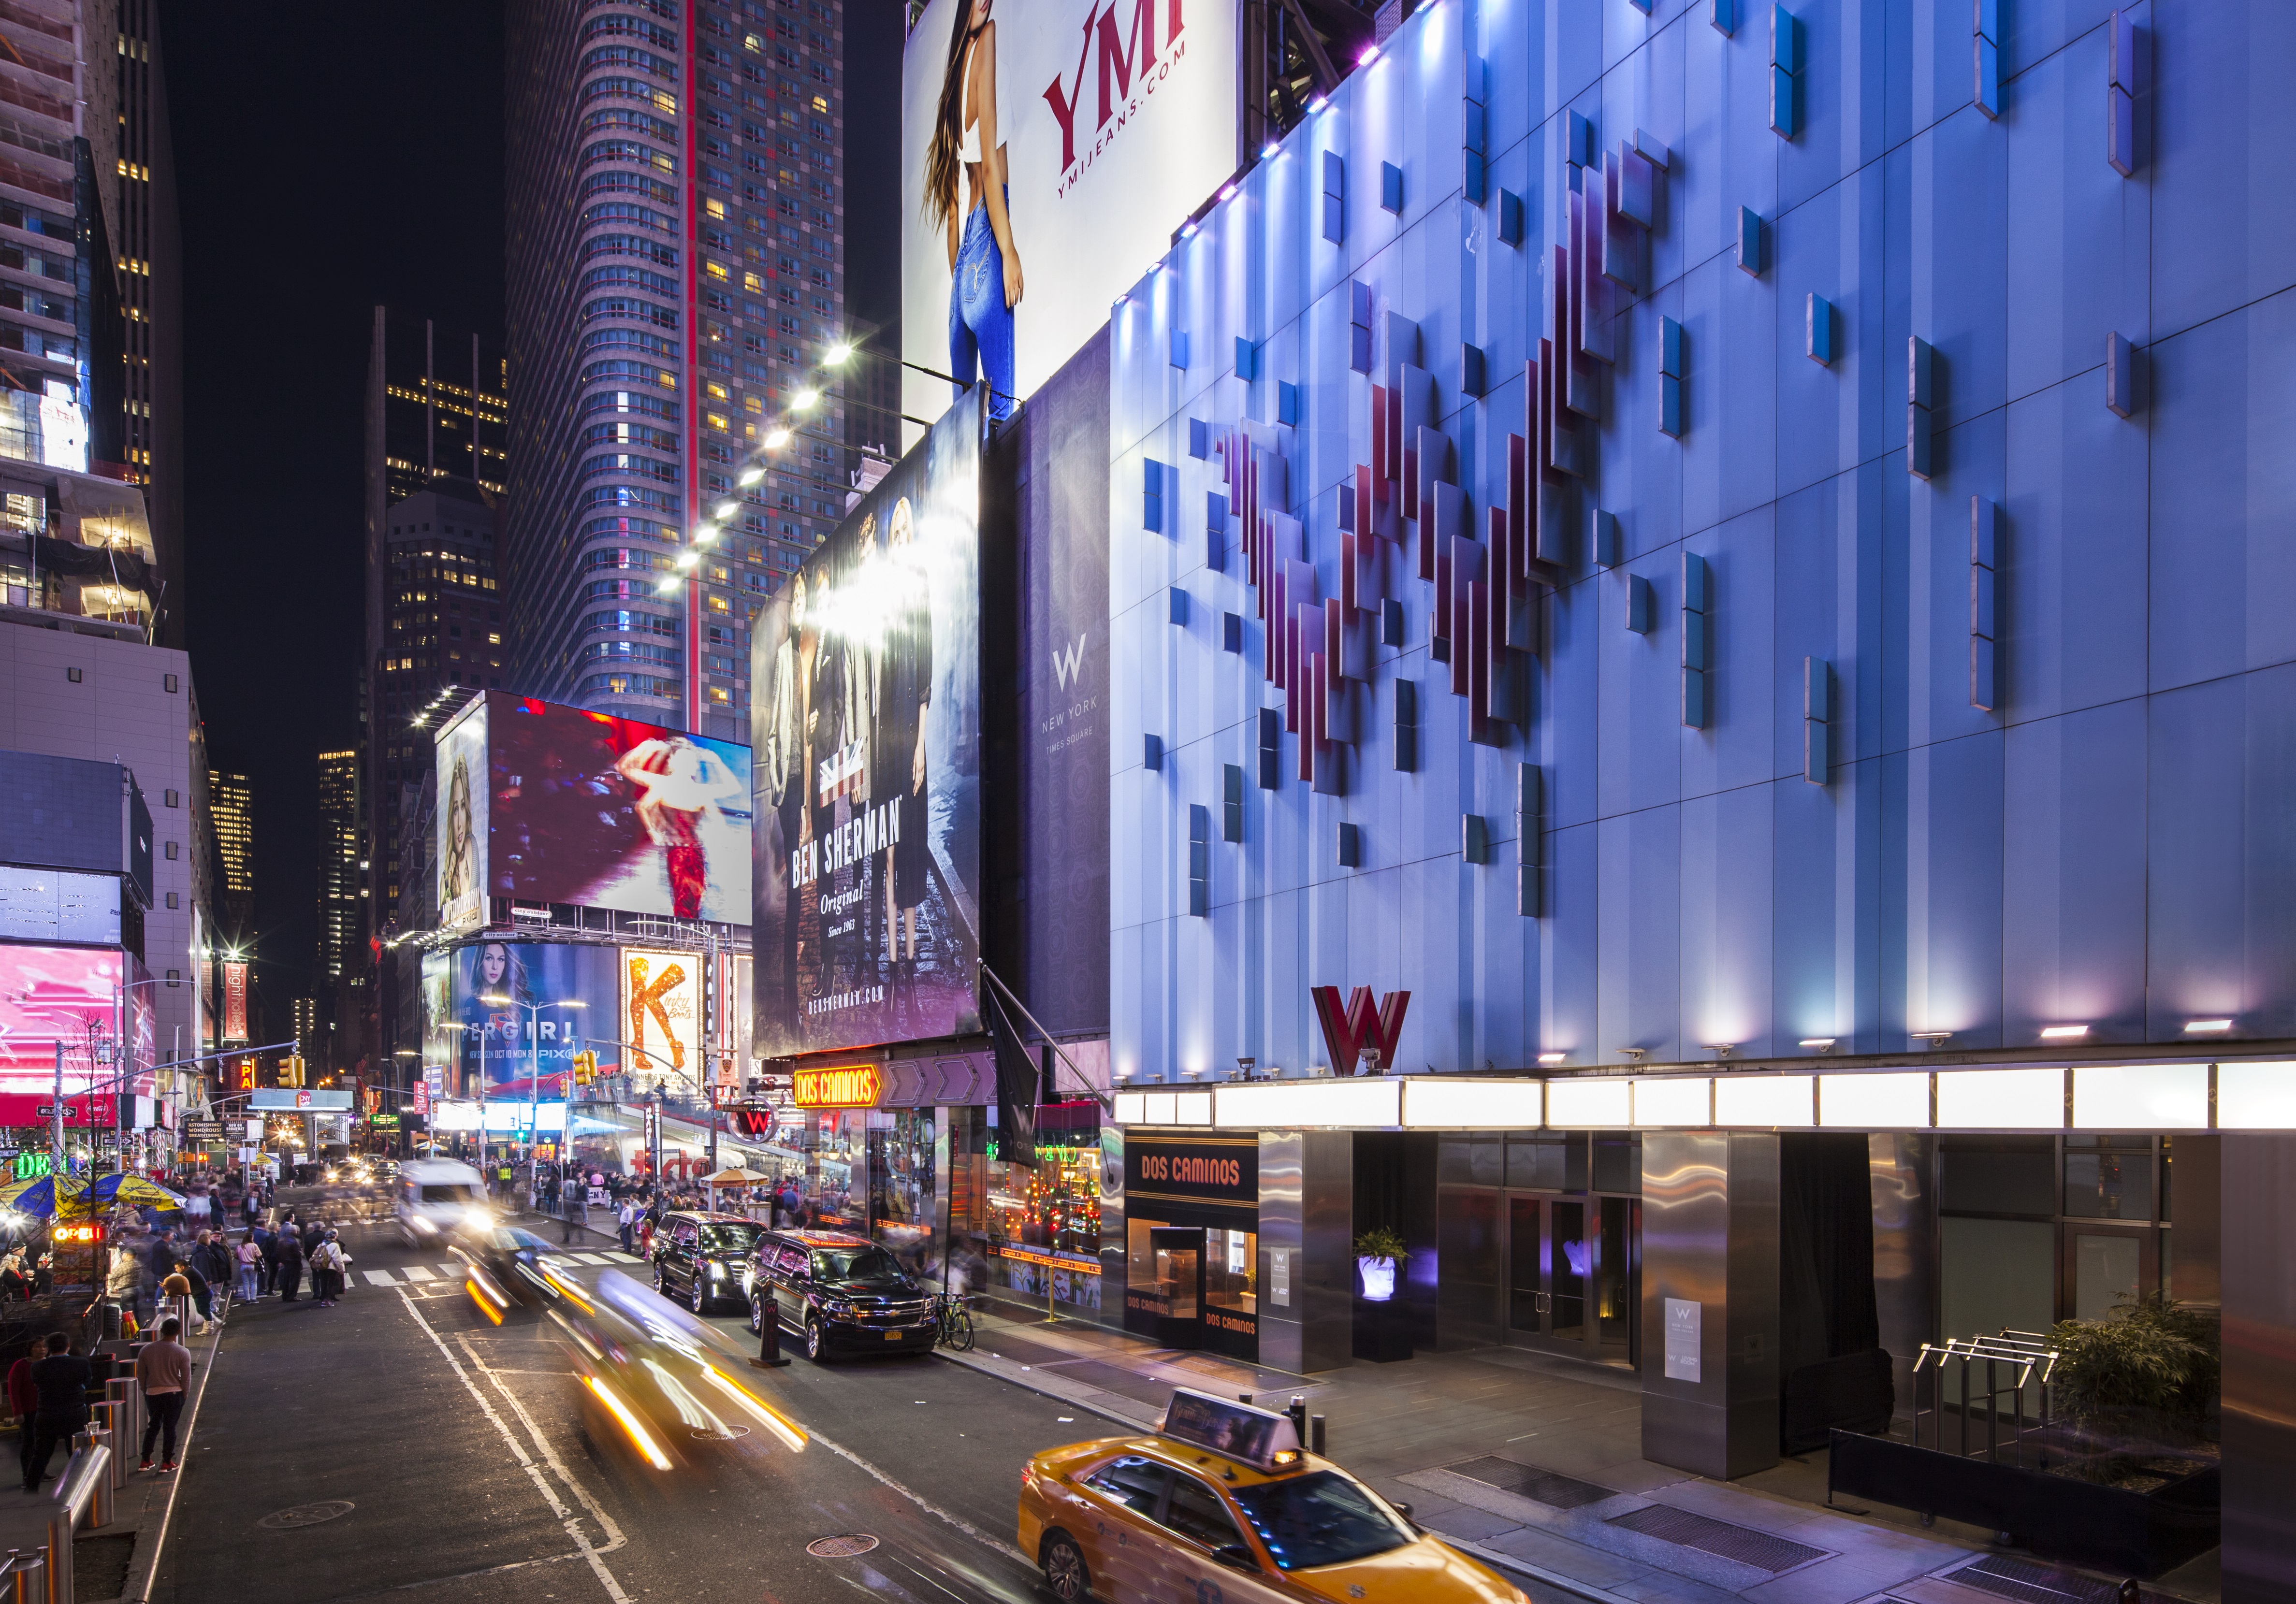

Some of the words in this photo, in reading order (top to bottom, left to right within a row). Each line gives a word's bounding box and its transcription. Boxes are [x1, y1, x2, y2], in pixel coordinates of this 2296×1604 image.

[1058, 40, 1184, 199] YMIJEANS.COM
[1053, 633, 1086, 693] W
[1042, 712, 1064, 734] NEW
[1068, 696, 1097, 720] YORK
[1046, 739, 1064, 755] TIMES
[1067, 726, 1092, 745] SQUARE
[792, 839, 817, 889] BEN
[825, 796, 900, 874] SHERMAN
[820, 880, 863, 915] Original
[828, 924, 842, 939] Since
[843, 919, 855, 933] 1963
[809, 985, 884, 1015] BENSHERMAN.COM
[1311, 984, 1411, 1077] W
[495, 1050, 505, 1058] OCT
[506, 1050, 511, 1058] 10
[513, 1049, 526, 1058] MON
[797, 1074, 817, 1104] DOS
[820, 1069, 872, 1103] CAMINOS
[746, 1111, 770, 1134] W
[1142, 1156, 1168, 1180] DOS
[1172, 1157, 1240, 1185] CAMINOS
[1276, 1253, 1284, 1262] W
[767, 1305, 776, 1313] W
[1128, 1297, 1139, 1309] DOS
[1141, 1299, 1168, 1315] CAMINOS
[1676, 1307, 1690, 1320] W
[1206, 1313, 1220, 1327] DOS
[1222, 1316, 1255, 1335] CAMINOS
